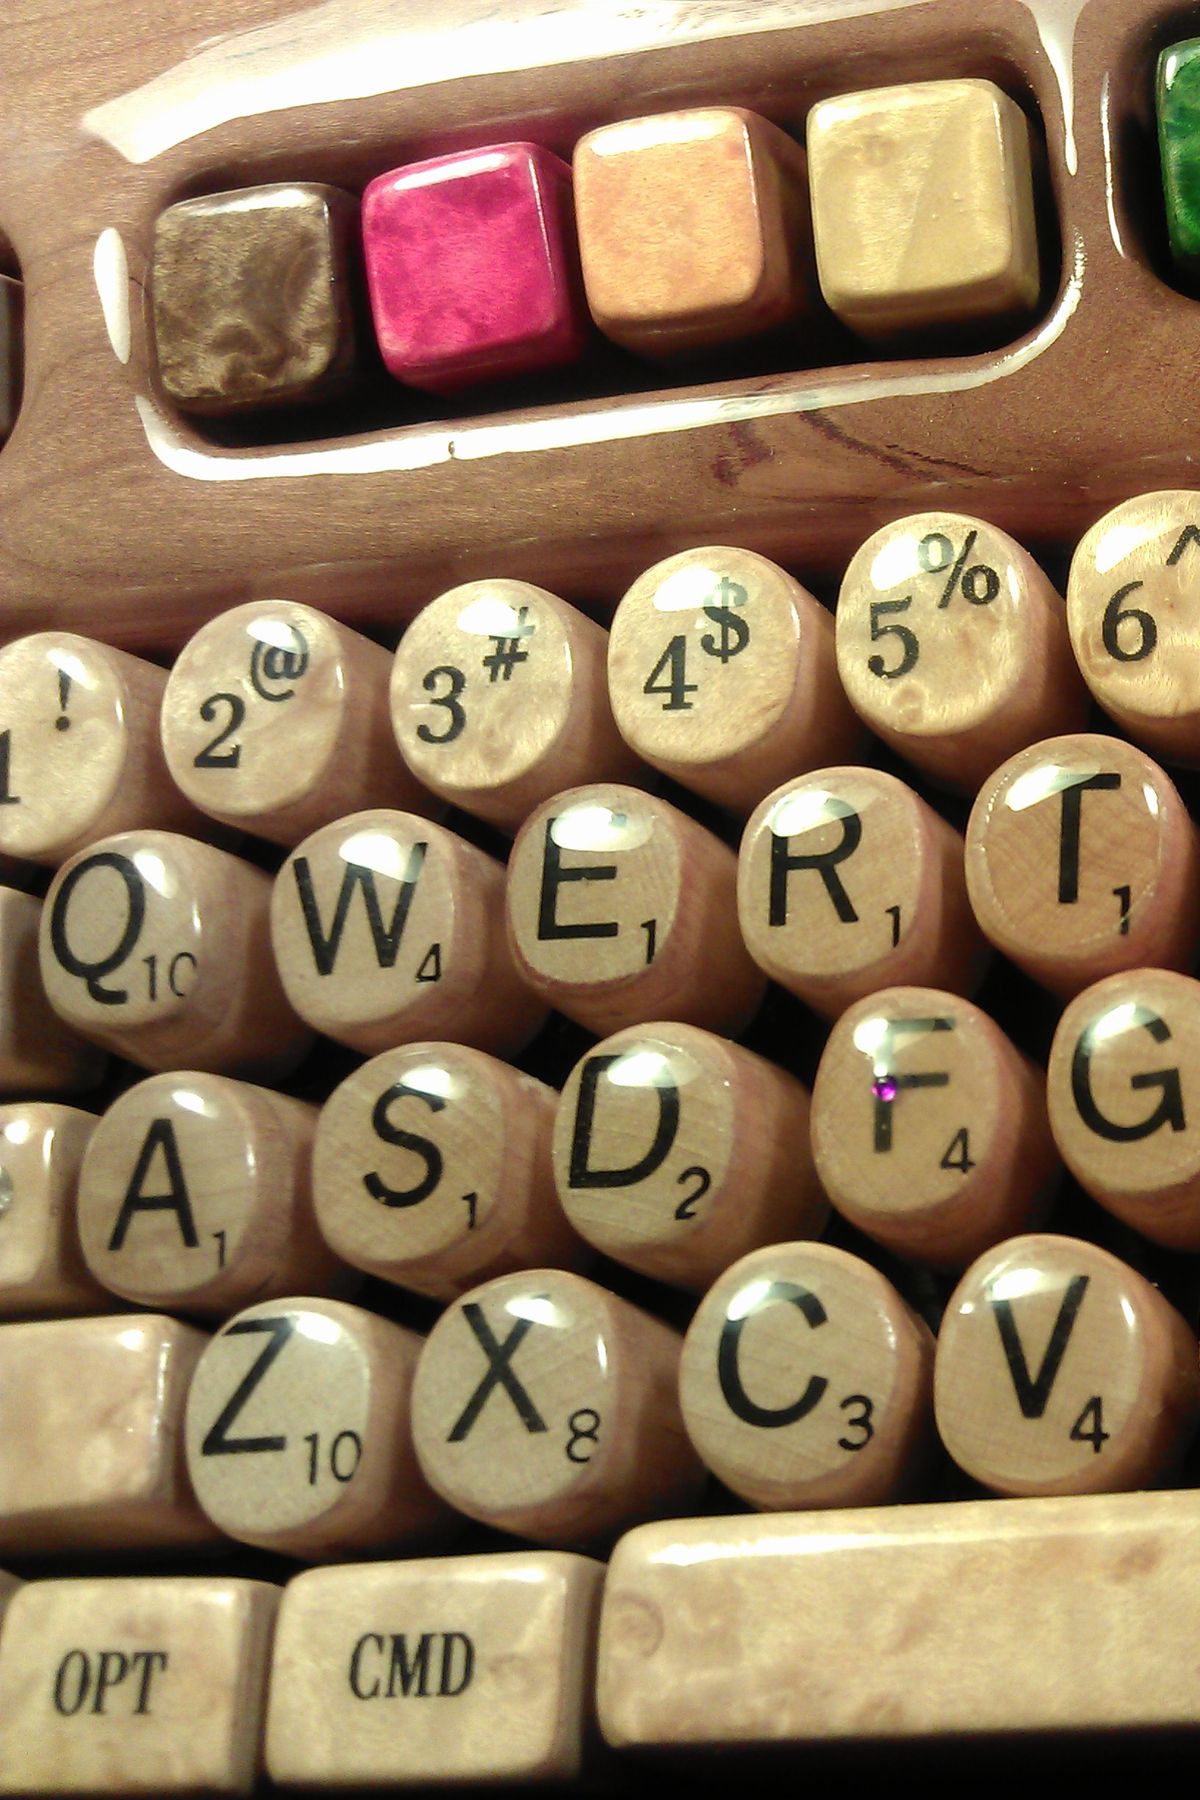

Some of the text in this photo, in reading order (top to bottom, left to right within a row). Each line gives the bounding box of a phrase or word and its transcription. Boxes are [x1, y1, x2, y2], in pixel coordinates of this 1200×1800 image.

[643, 576, 749, 711] 4 $
[868, 530, 1000, 679] 5 %
[1102, 581, 1157, 662] 6
[193, 624, 309, 769] 2 @
[416, 666, 467, 743] 3
[293, 841, 443, 983] W 4
[538, 817, 659, 965] E 1
[769, 800, 901, 948] R 1
[1006, 772, 1132, 935] T 1
[50, 852, 145, 1005] Q
[568, 1055, 712, 1220] D 2
[873, 1017, 975, 1175] F 4
[1071, 1004, 1186, 1143] G
[107, 1118, 228, 1268] A 1
[363, 1082, 478, 1228] S 1
[200, 1317, 363, 1486] Z 10
[447, 1294, 600, 1464] X 8
[717, 1281, 875, 1451] C 3
[988, 1274, 1110, 1454] V 4
[54, 1650, 168, 1716] OPT
[349, 1631, 475, 1700] CMD
